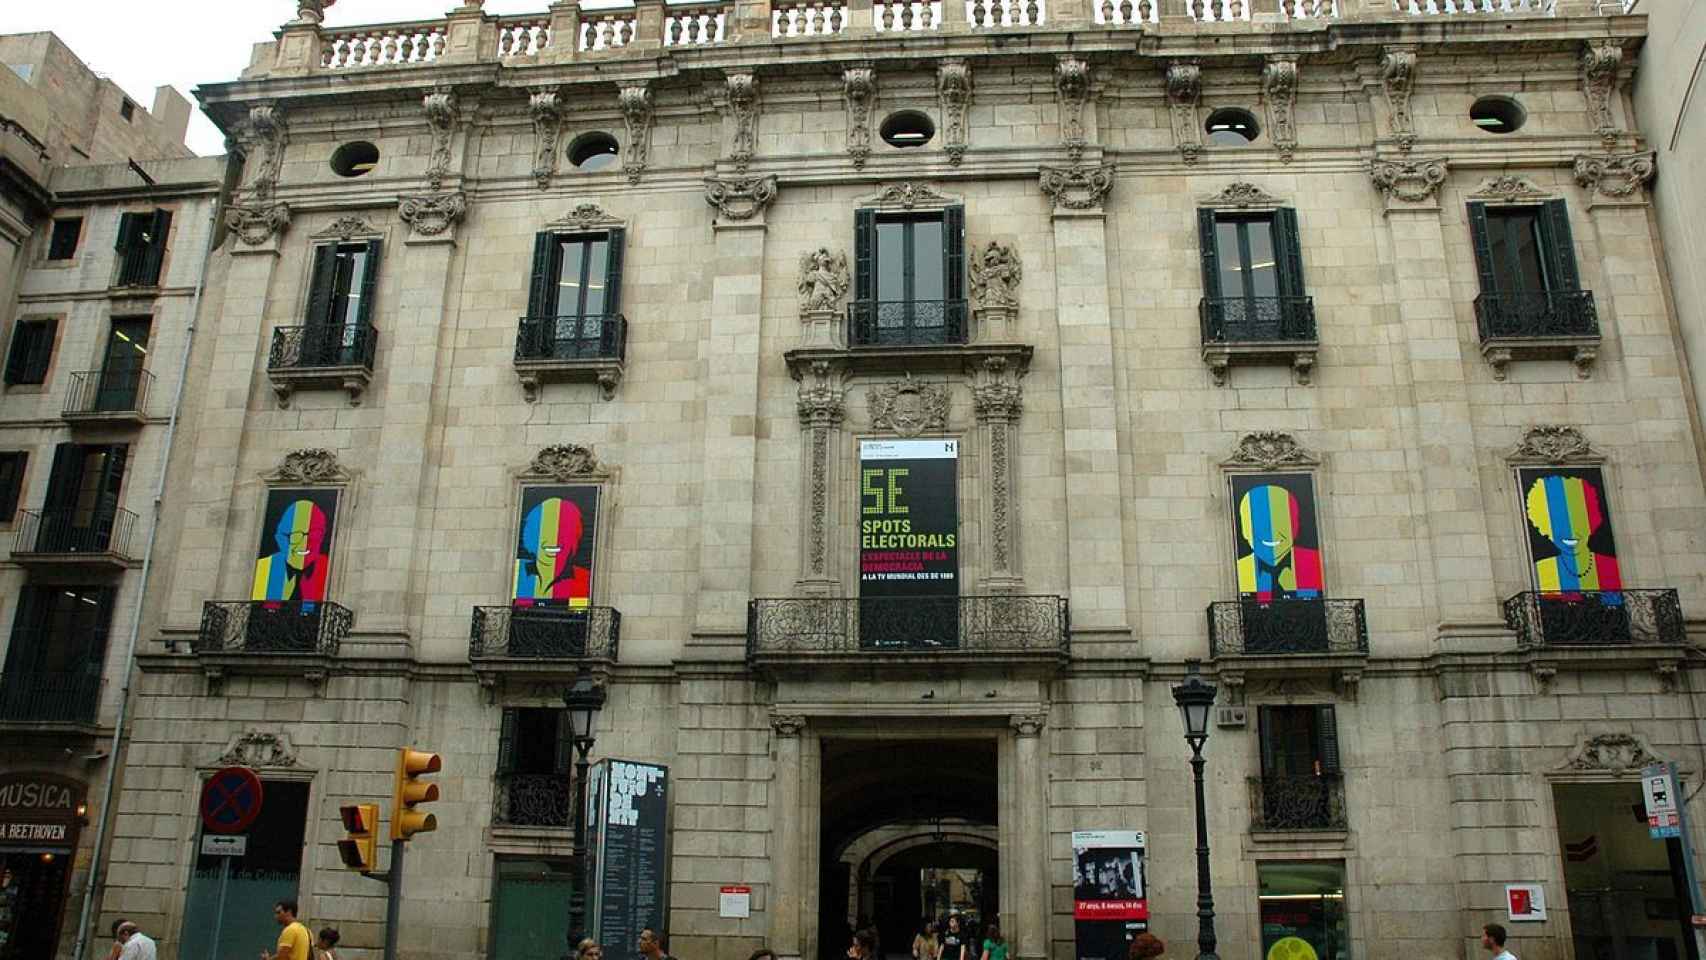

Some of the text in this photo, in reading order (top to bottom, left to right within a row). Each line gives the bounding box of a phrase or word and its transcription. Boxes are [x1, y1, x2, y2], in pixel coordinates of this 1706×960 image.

[863, 519, 911, 534] SPOTS
[863, 534, 956, 549] ELECTORALS
[862, 572, 867, 580] A
[868, 572, 876, 580] LA
[878, 572, 886, 580] TV
[9, 823, 67, 840] BEETHOVEN
